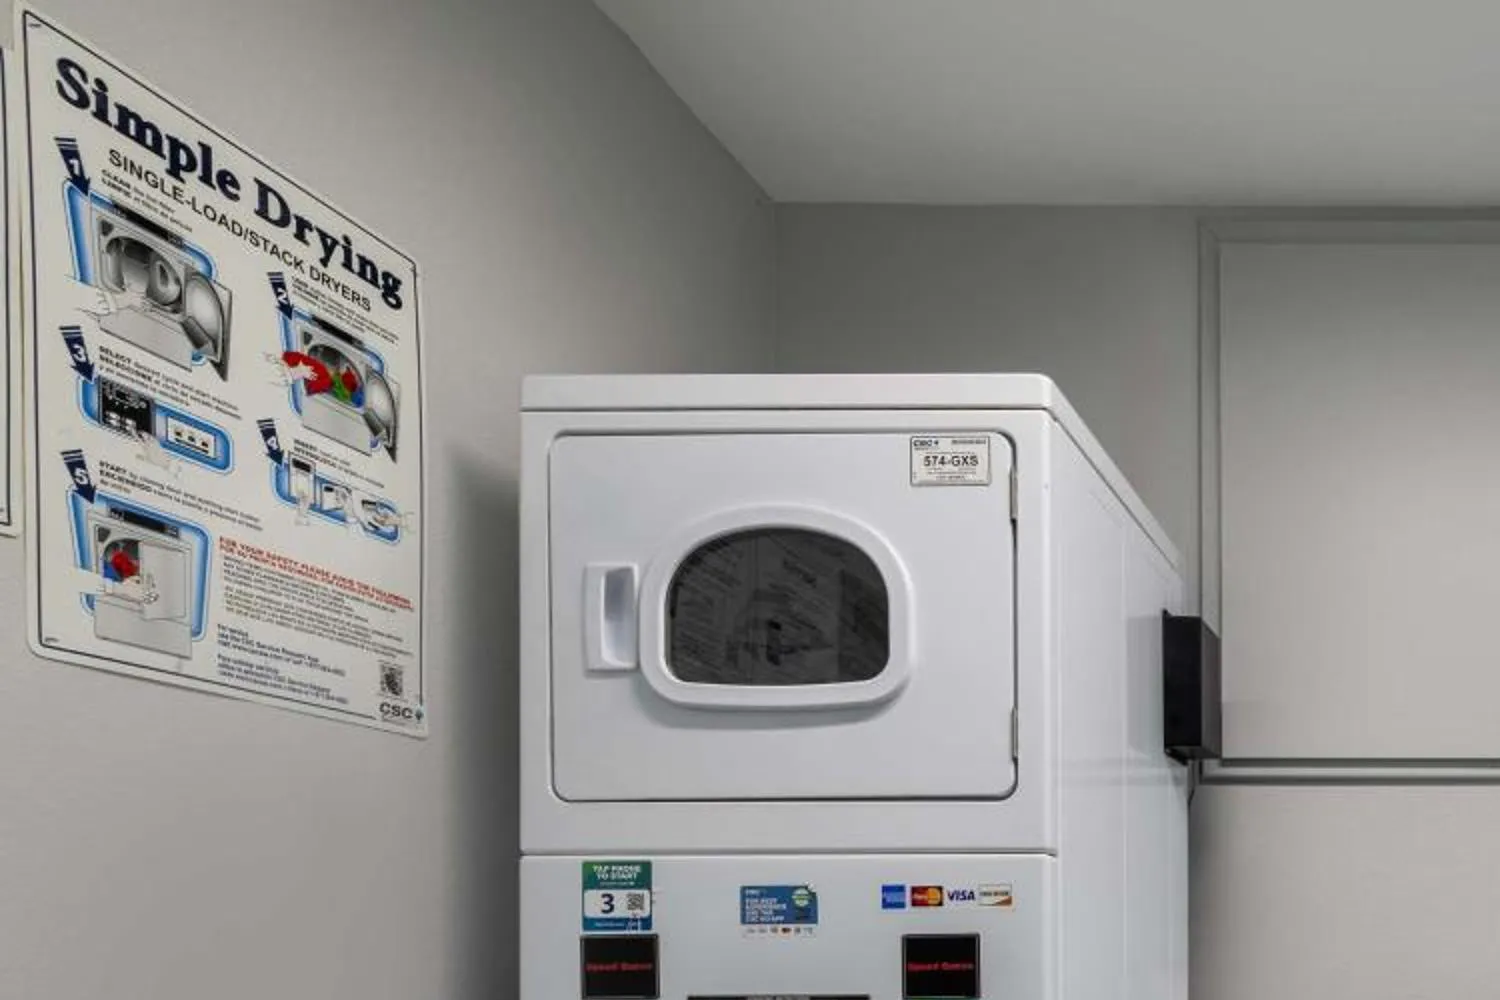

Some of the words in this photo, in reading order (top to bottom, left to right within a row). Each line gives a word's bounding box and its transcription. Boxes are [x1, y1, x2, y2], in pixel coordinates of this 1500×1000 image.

[56, 57, 241, 202] Simple
[254, 177, 402, 310] Drying
[109, 149, 304, 273] SINGLE-LOAD/STACK
[309, 266, 371, 312] DRYERS
[73, 343, 86, 362] 3
[923, 455, 979, 467] 574-GXS
[74, 468, 87, 485] 5
[379, 702, 413, 719] CSC
[601, 893, 614, 914] 3
[947, 889, 976, 901] VISA
